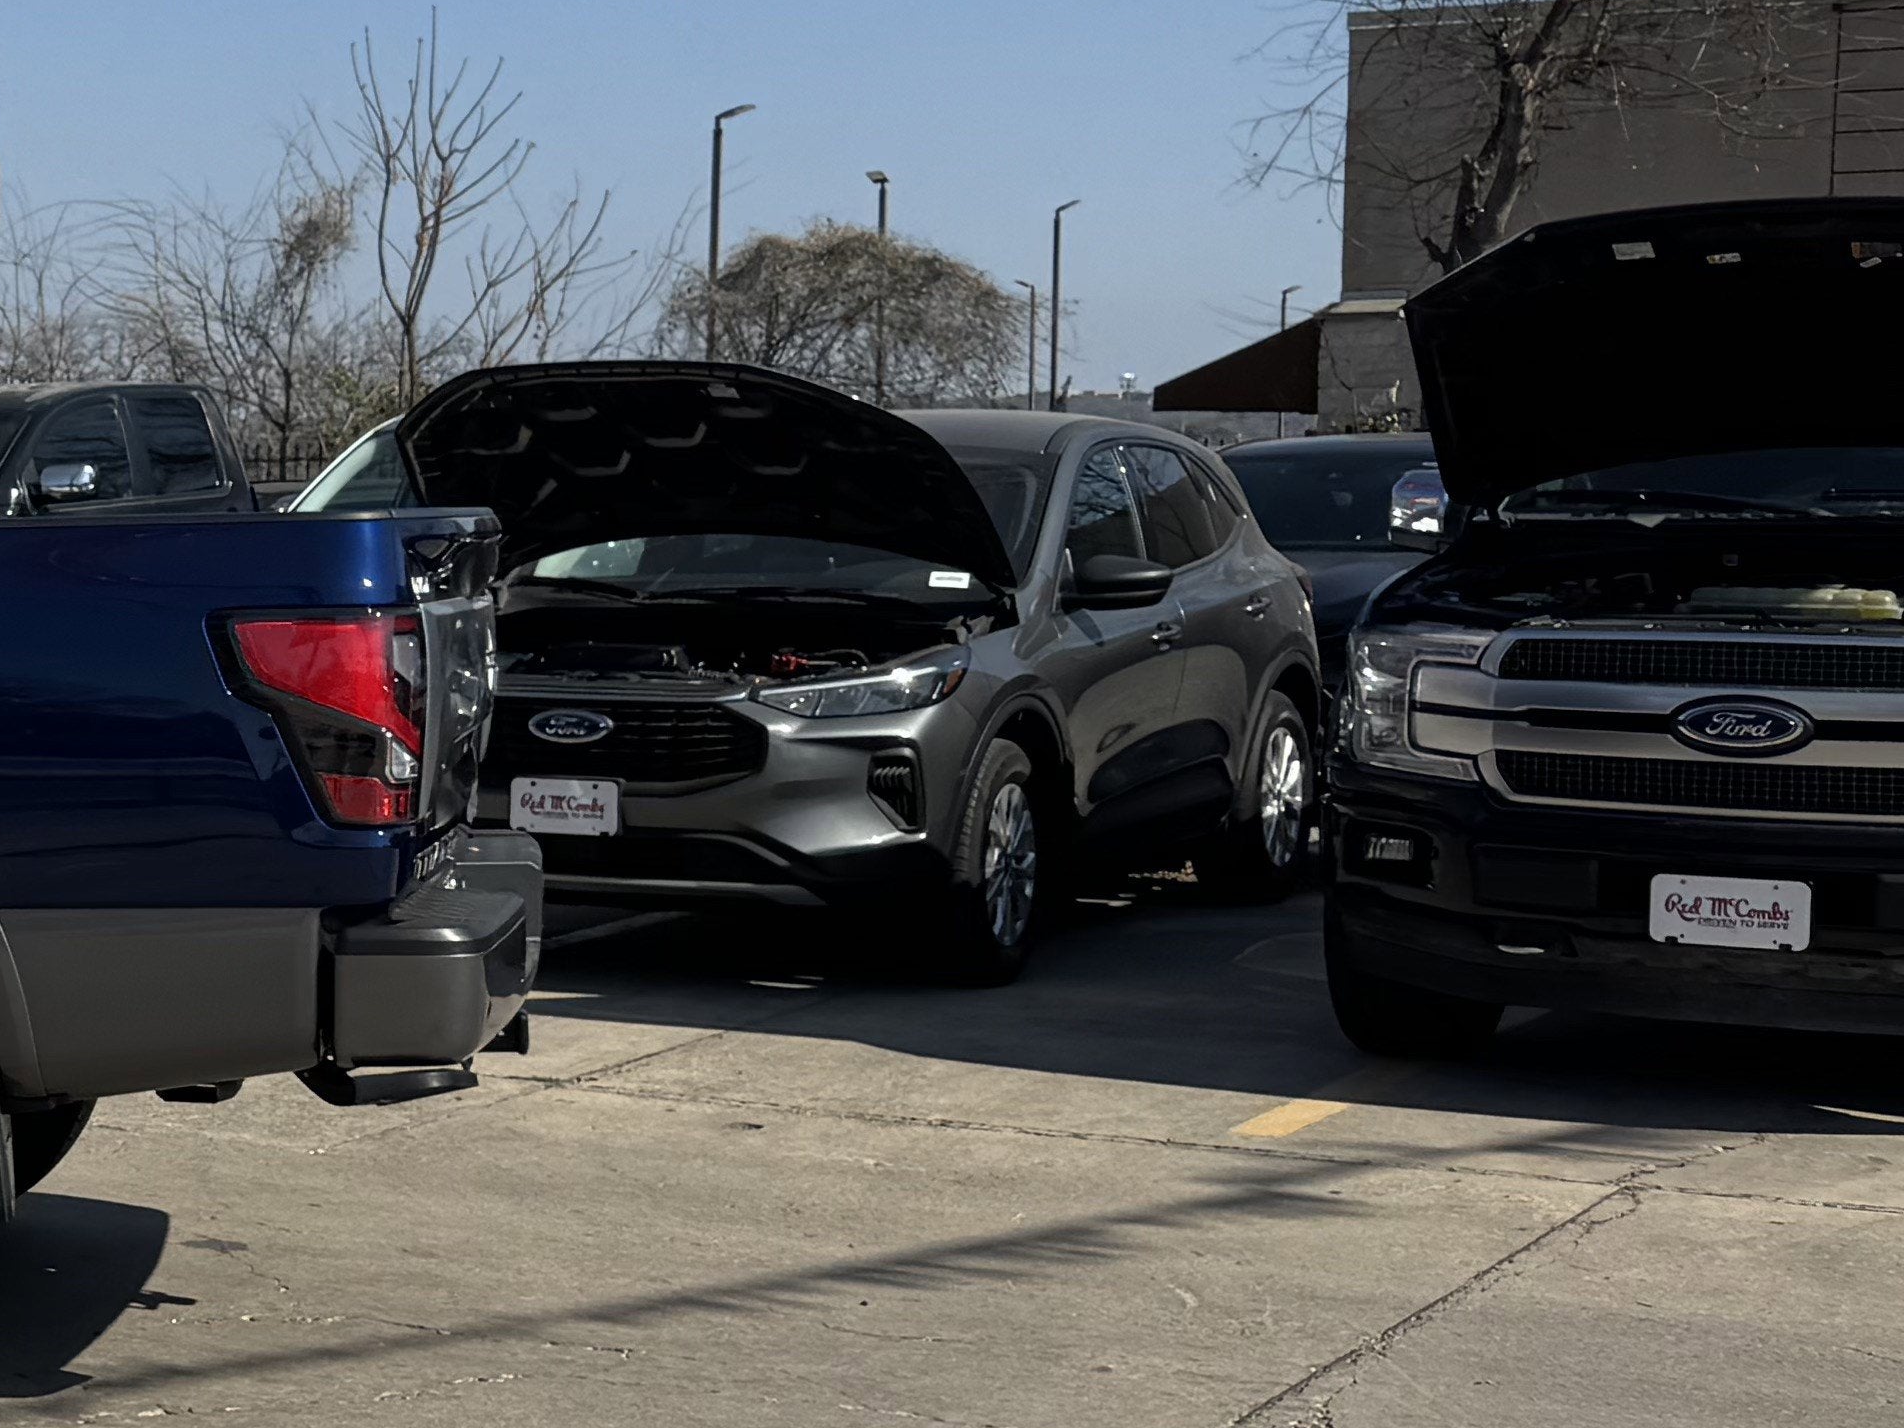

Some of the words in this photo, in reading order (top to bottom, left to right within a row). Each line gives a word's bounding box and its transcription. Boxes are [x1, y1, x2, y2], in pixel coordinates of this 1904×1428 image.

[1705, 711, 1773, 737] Ford
[1664, 892, 1703, 922] Red
[1705, 895, 1793, 922] McCombs
